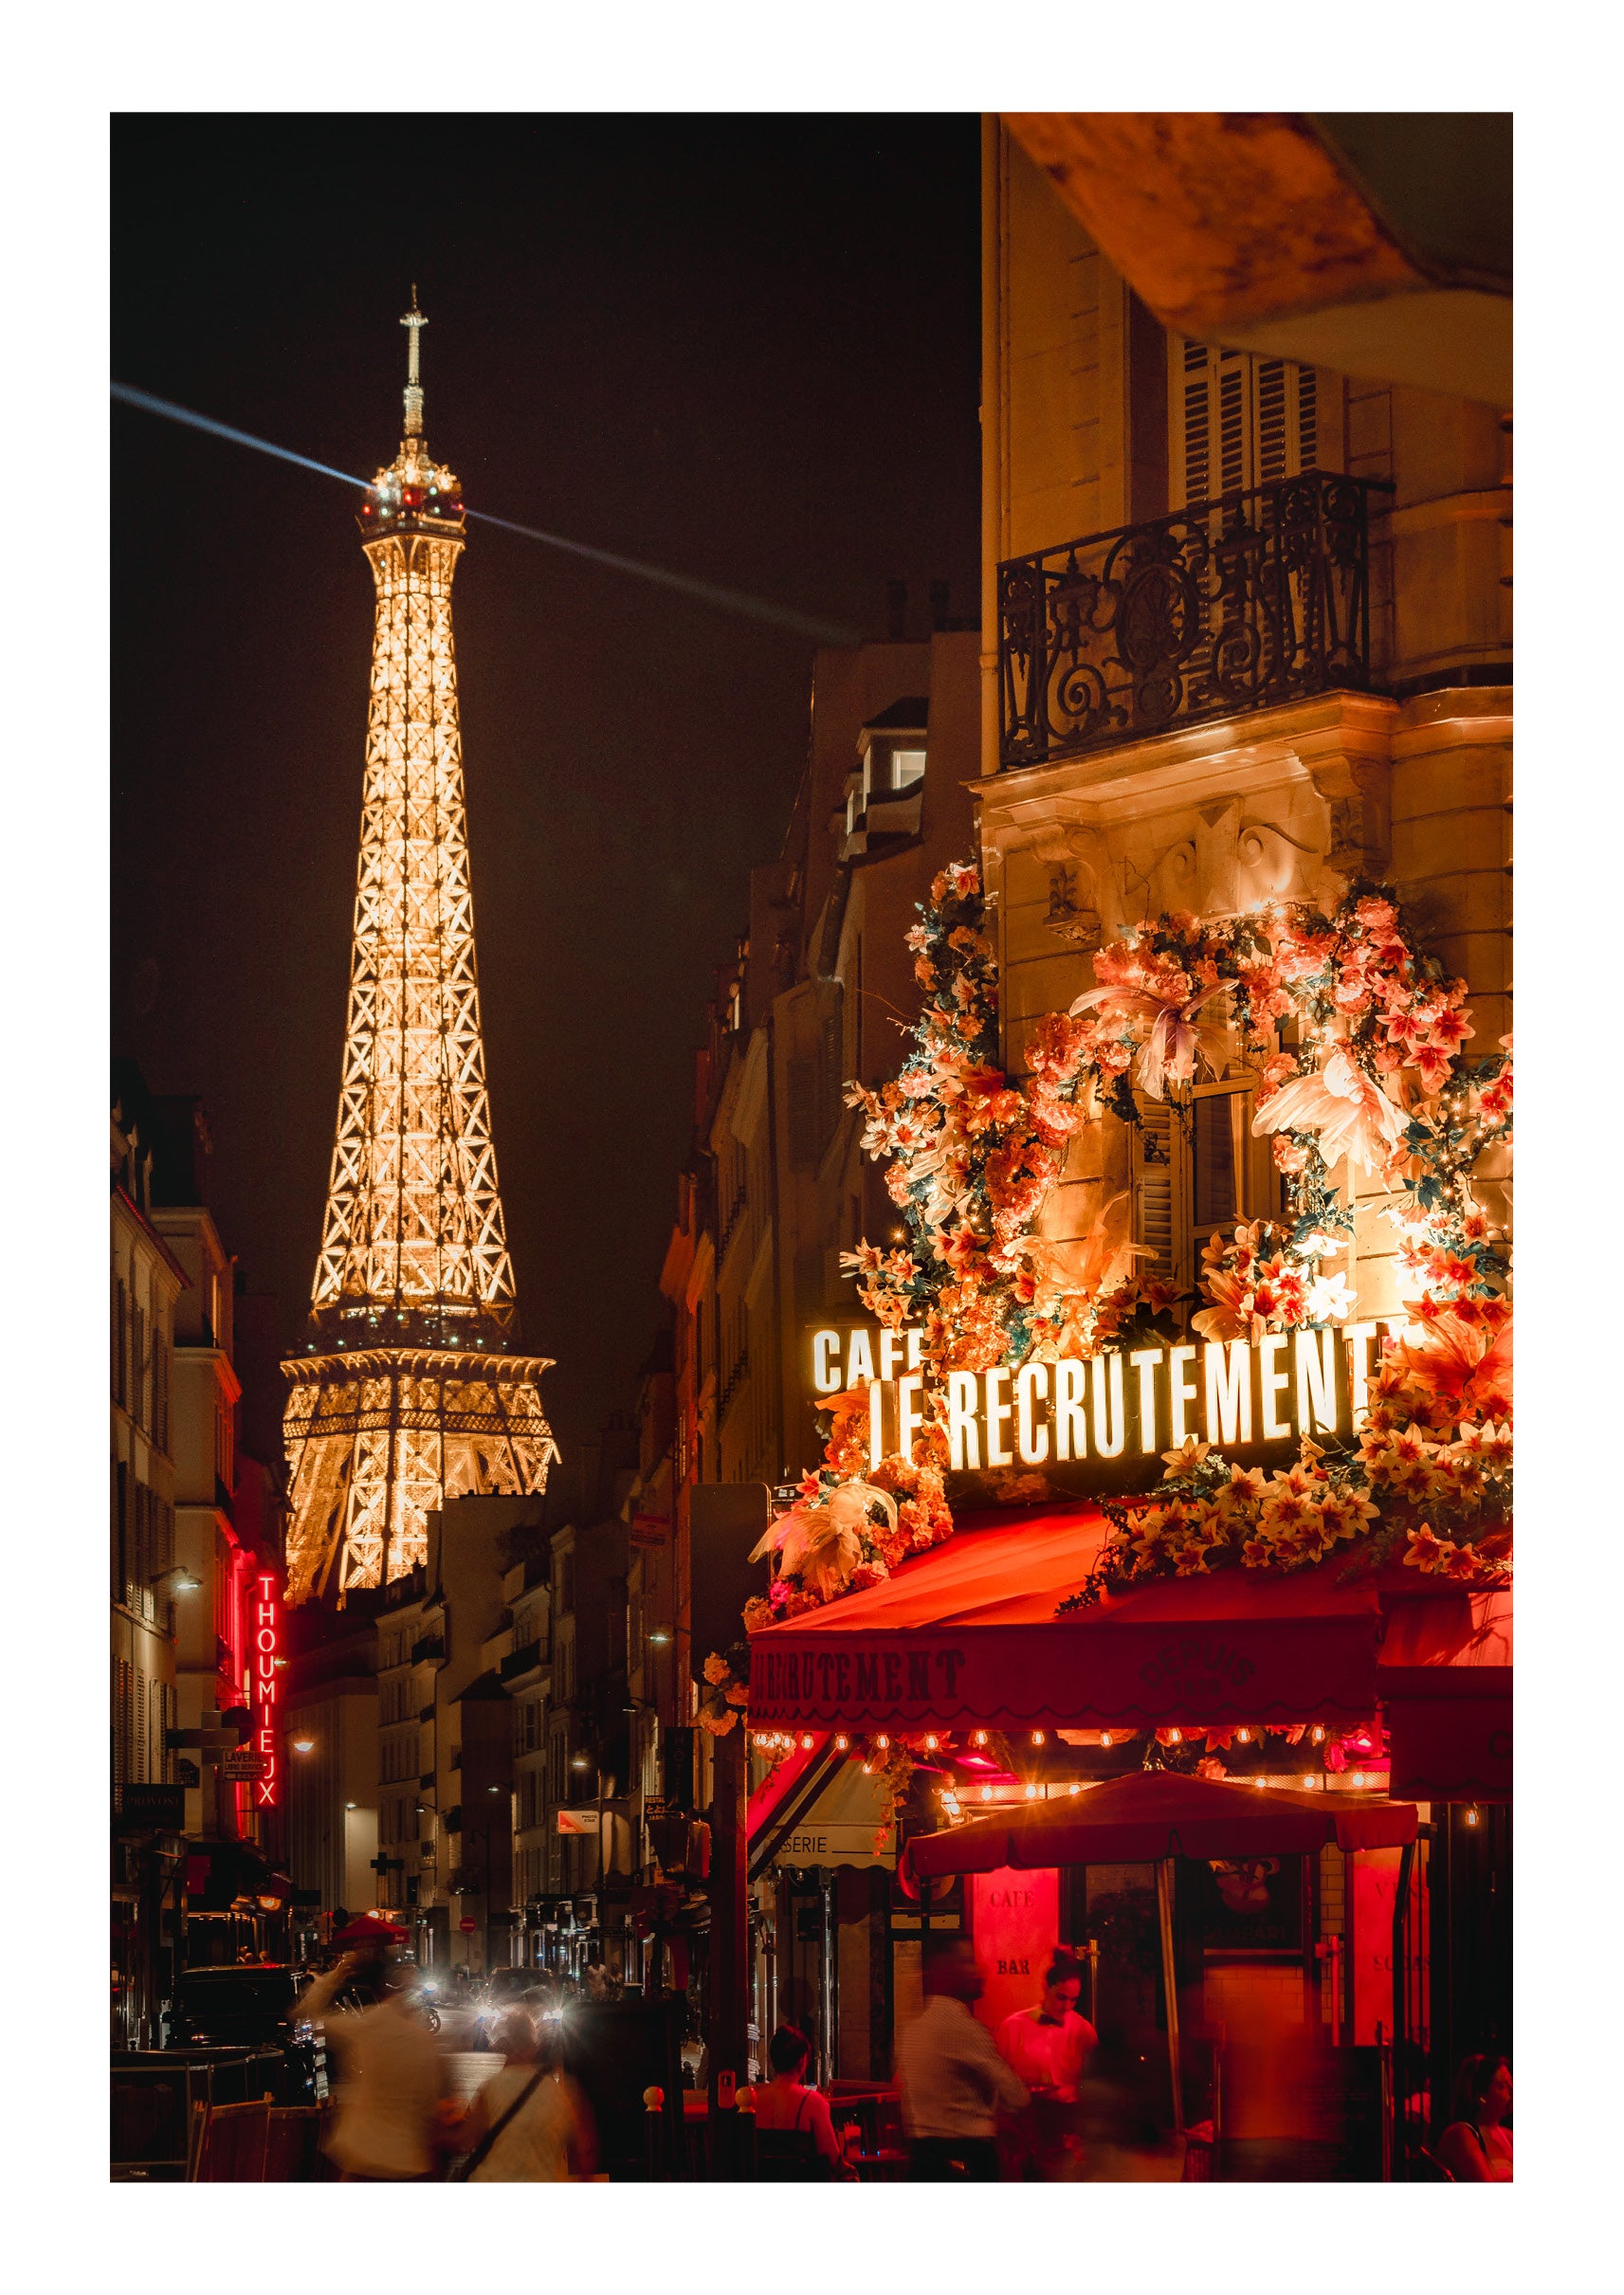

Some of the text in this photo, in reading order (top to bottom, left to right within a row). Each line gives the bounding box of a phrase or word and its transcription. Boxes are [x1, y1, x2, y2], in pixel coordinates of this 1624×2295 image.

[949, 1322, 1378, 1470] RECRUTEMENT
[1139, 1641, 1255, 1688] DEPUIS
[1175, 1679, 1221, 1697] 1870
[997, 1959, 1031, 1975] BAR
